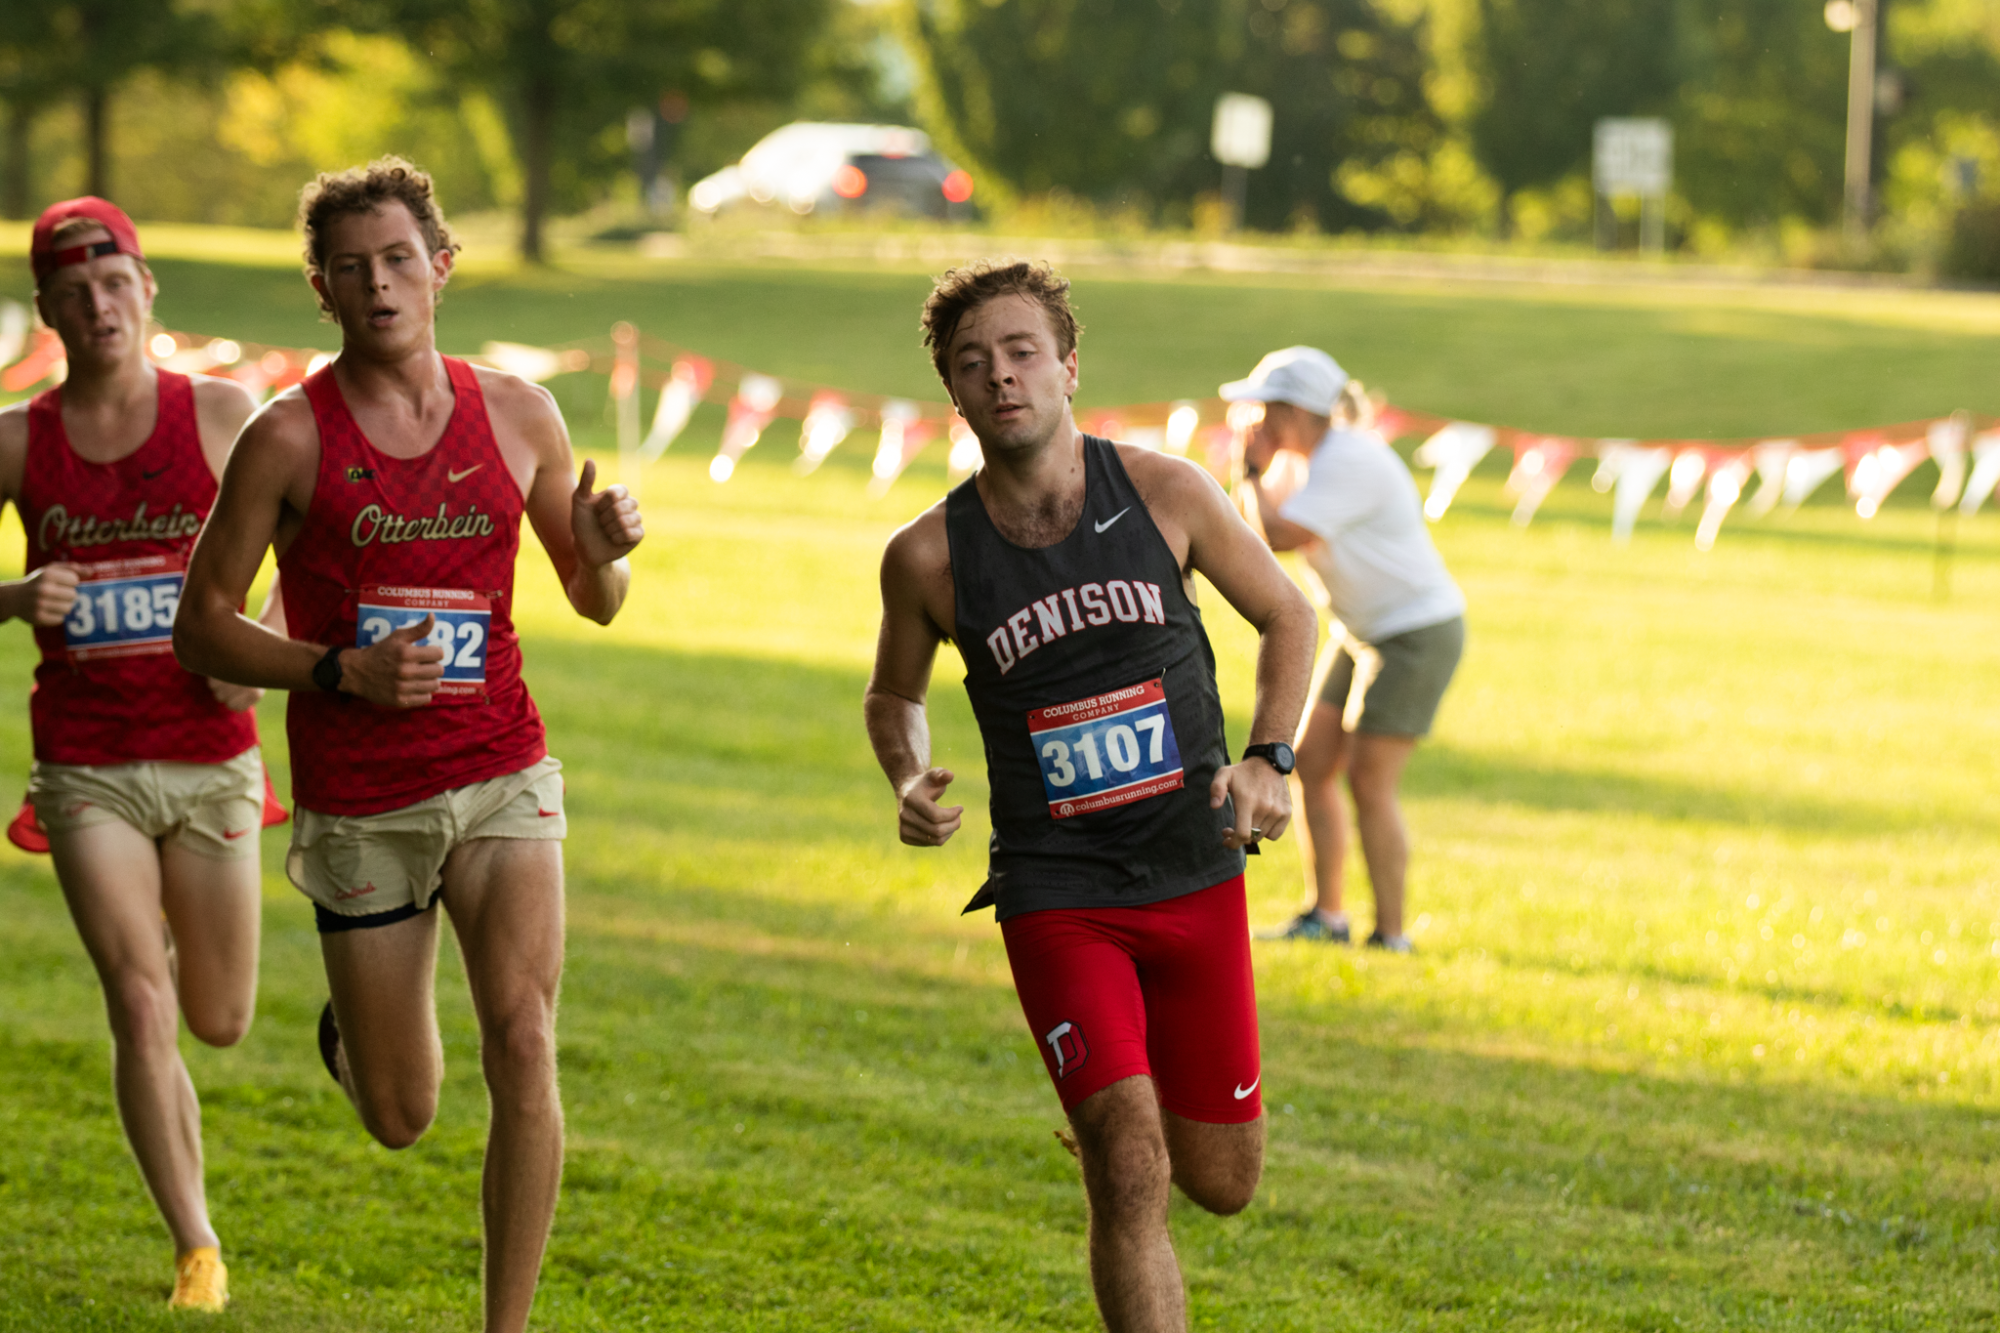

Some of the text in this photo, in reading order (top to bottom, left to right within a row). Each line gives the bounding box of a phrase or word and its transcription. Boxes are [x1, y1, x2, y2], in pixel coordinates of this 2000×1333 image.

[39, 502, 200, 551] Otterbein
[351, 503, 494, 547] Otterbein
[66, 582, 181, 637] 3185
[377, 586, 475, 602] COLUMBUS RUNNING
[404, 598, 449, 608] COMPANY
[986, 580, 1166, 676] DENISON
[1043, 685, 1145, 719] COLUMBUS RUNNING
[1072, 703, 1120, 721] COMPANY
[1041, 713, 1166, 788] 3107
[1075, 779, 1178, 812] columbusrunning.com
[1045, 1020, 1090, 1080] D
